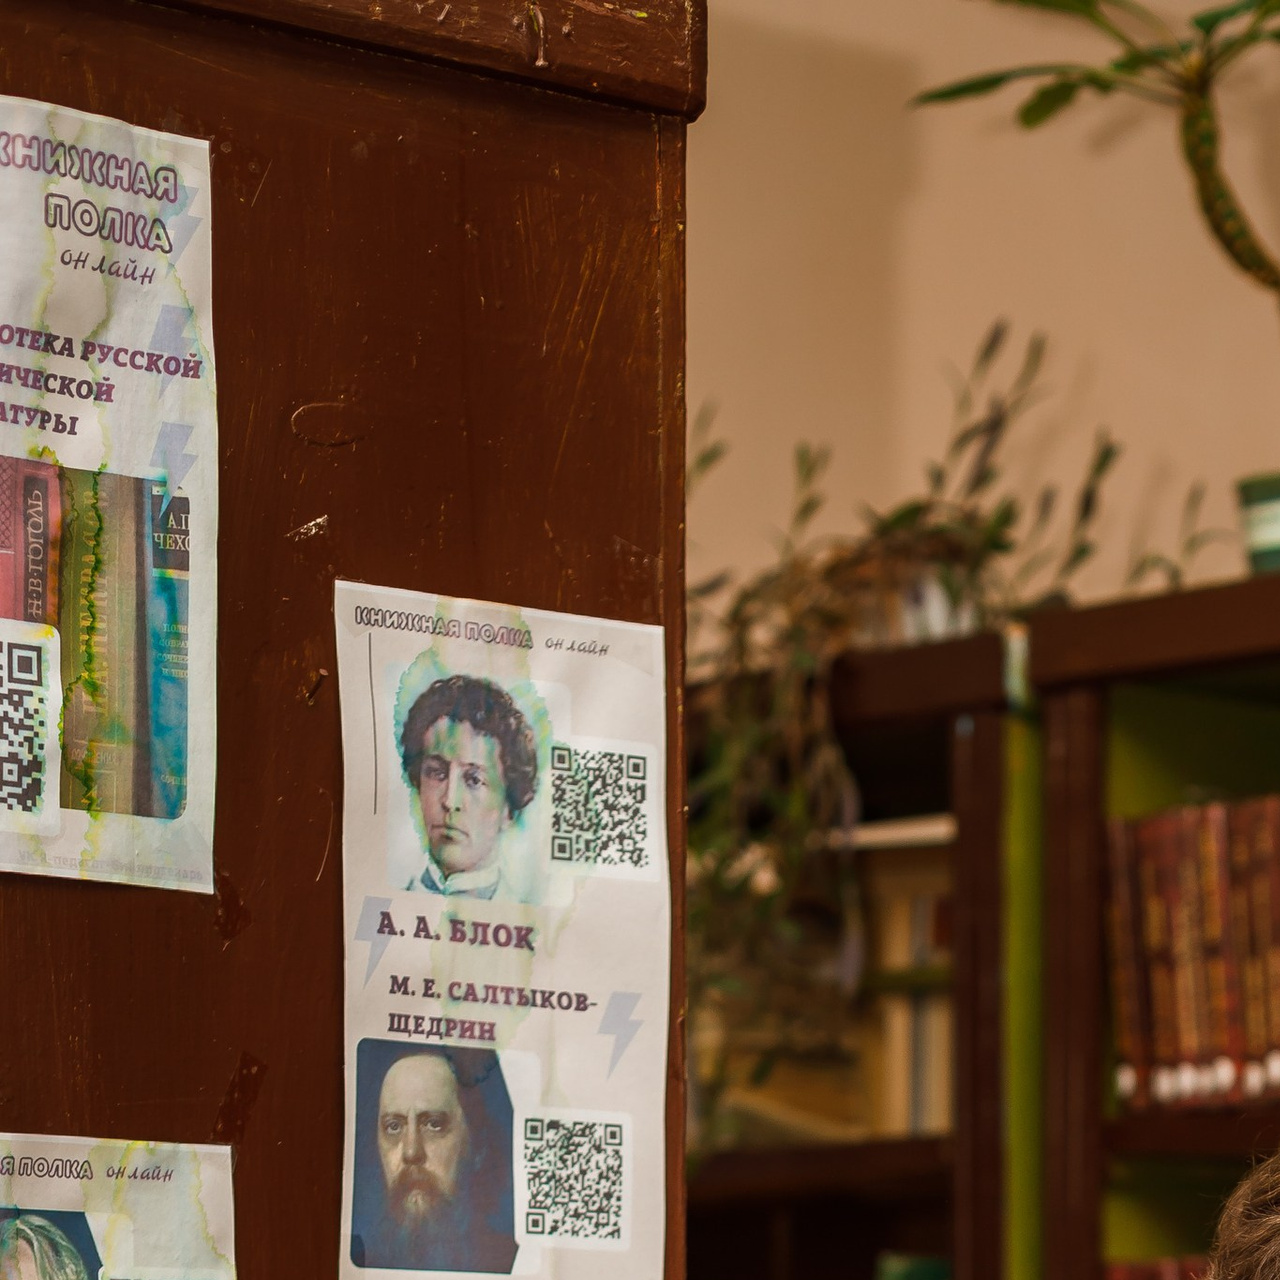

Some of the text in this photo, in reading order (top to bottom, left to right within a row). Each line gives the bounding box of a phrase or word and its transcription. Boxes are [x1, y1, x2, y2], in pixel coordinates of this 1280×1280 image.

[44, 192, 173, 254] ПОЛКА
[0, 324, 202, 379] ОТЕКА РУССКОЙ
[354, 605, 461, 637] КНИЖНАЯ
[465, 622, 534, 650] ПОЛКА
[376, 911, 536, 951] А. А. БЛОК
[388, 975, 598, 1013] М. Е. САЛТЫКОВ-
[388, 1012, 497, 1041] ЩЕДРИН
[18, 1157, 93, 1180] ПОЛКА
